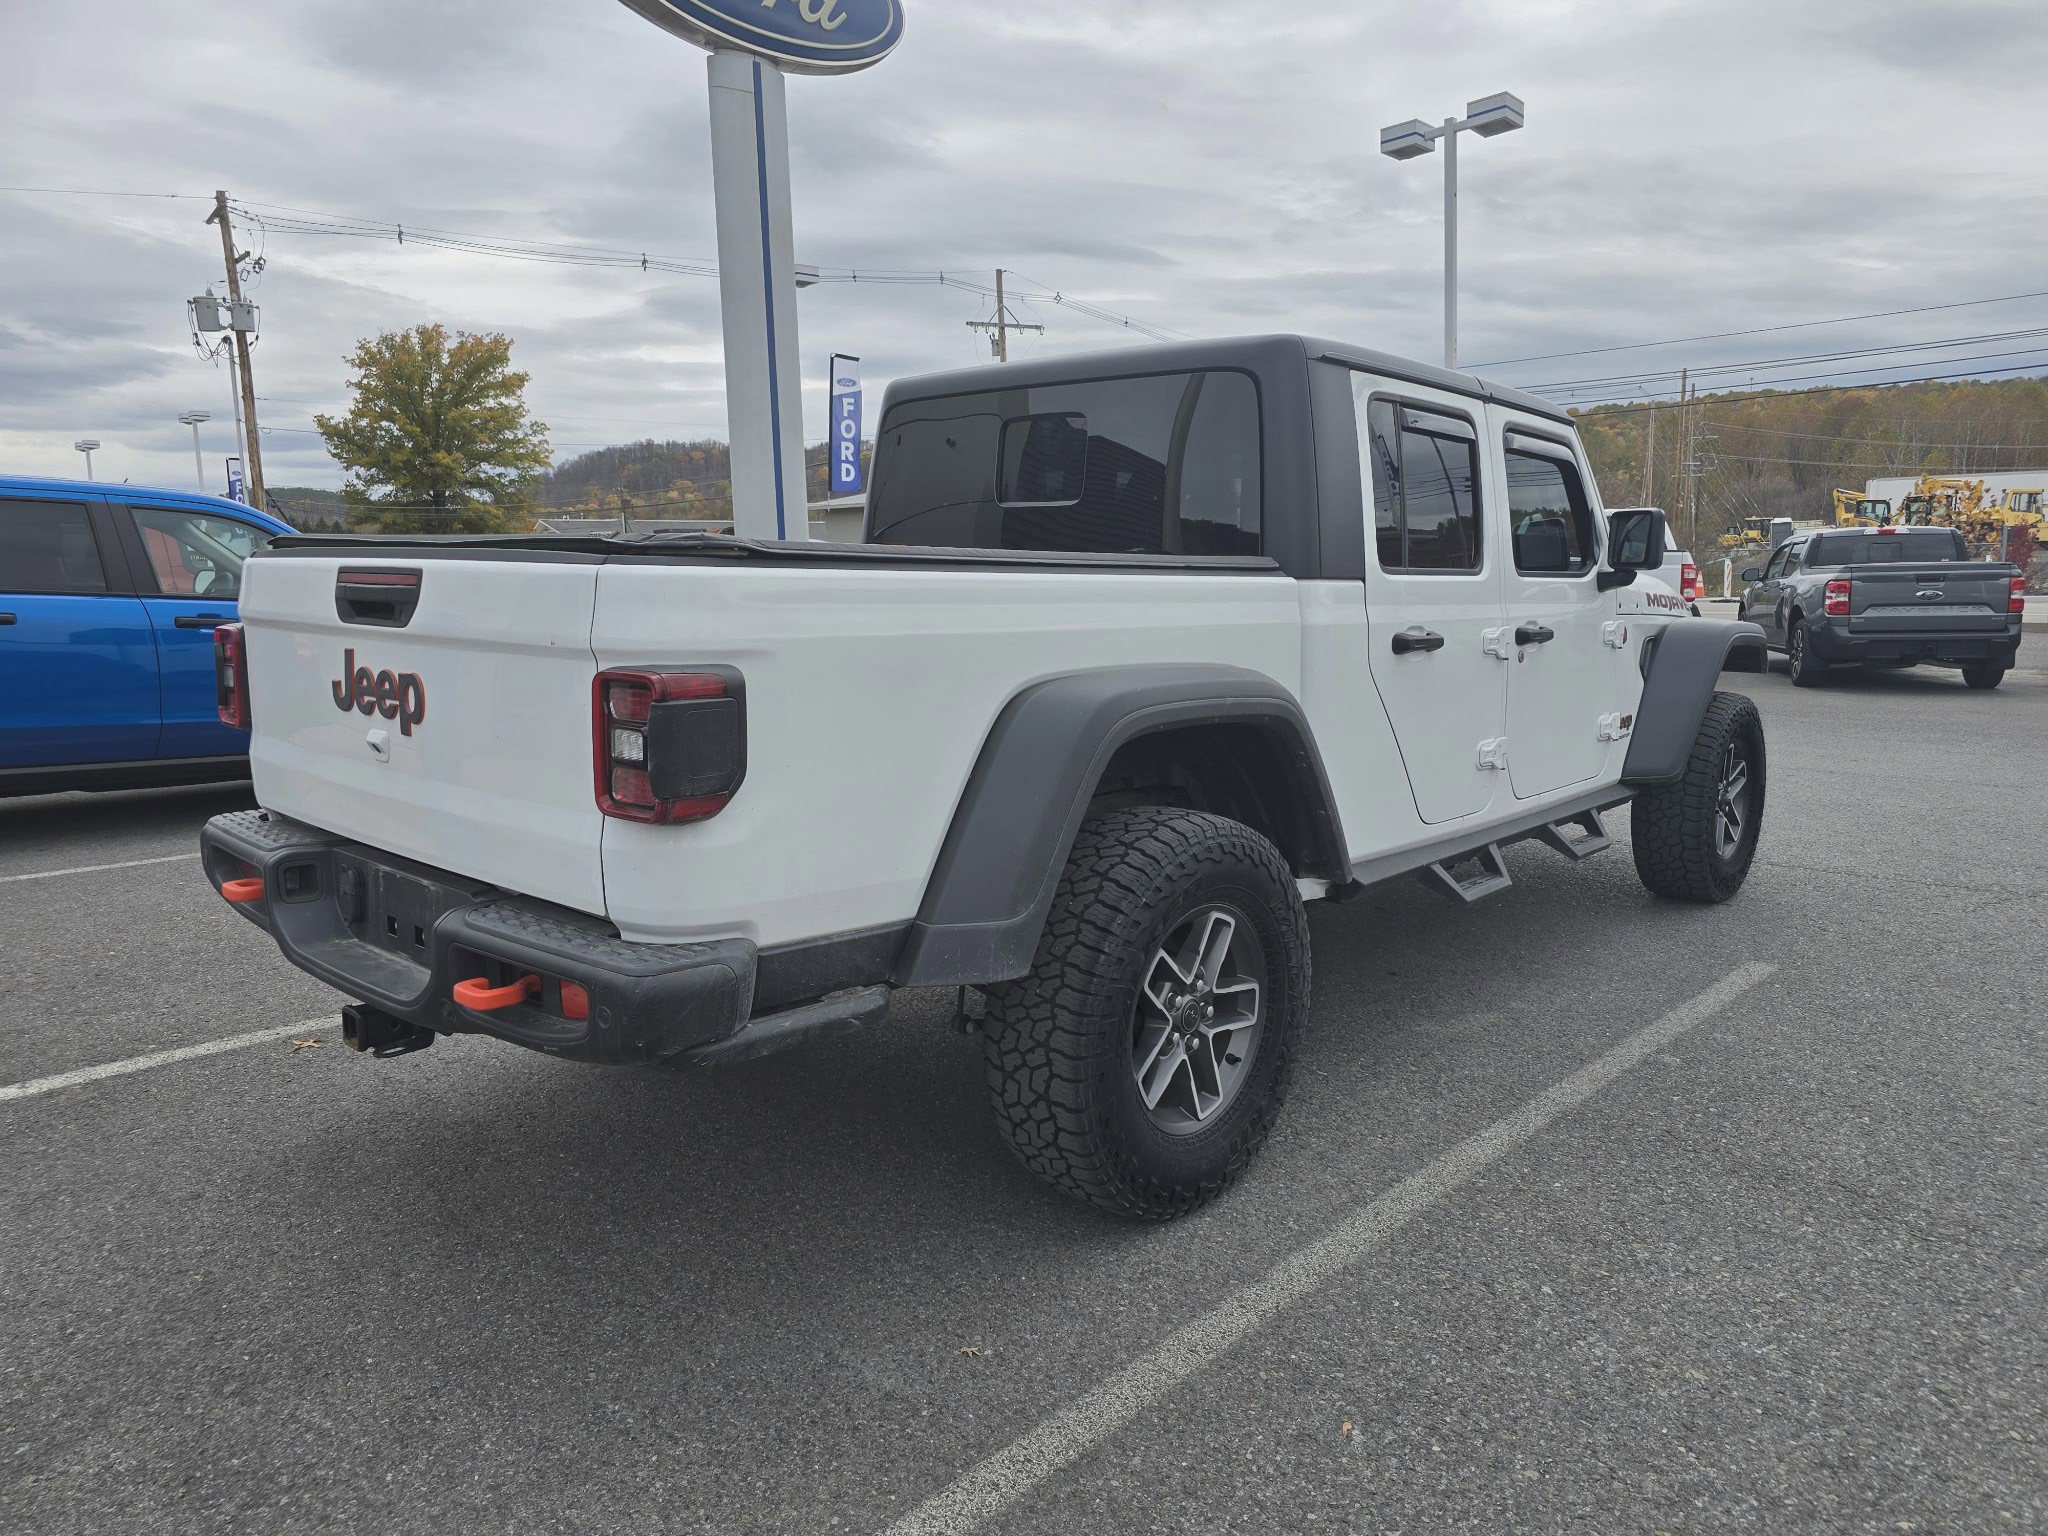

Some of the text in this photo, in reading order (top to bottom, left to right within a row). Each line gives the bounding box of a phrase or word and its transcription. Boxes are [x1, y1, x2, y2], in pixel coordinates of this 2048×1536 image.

[840, 398, 856, 482] FORD
[1872, 606, 1985, 614] MAVERICK
[331, 648, 426, 737] Jeep
